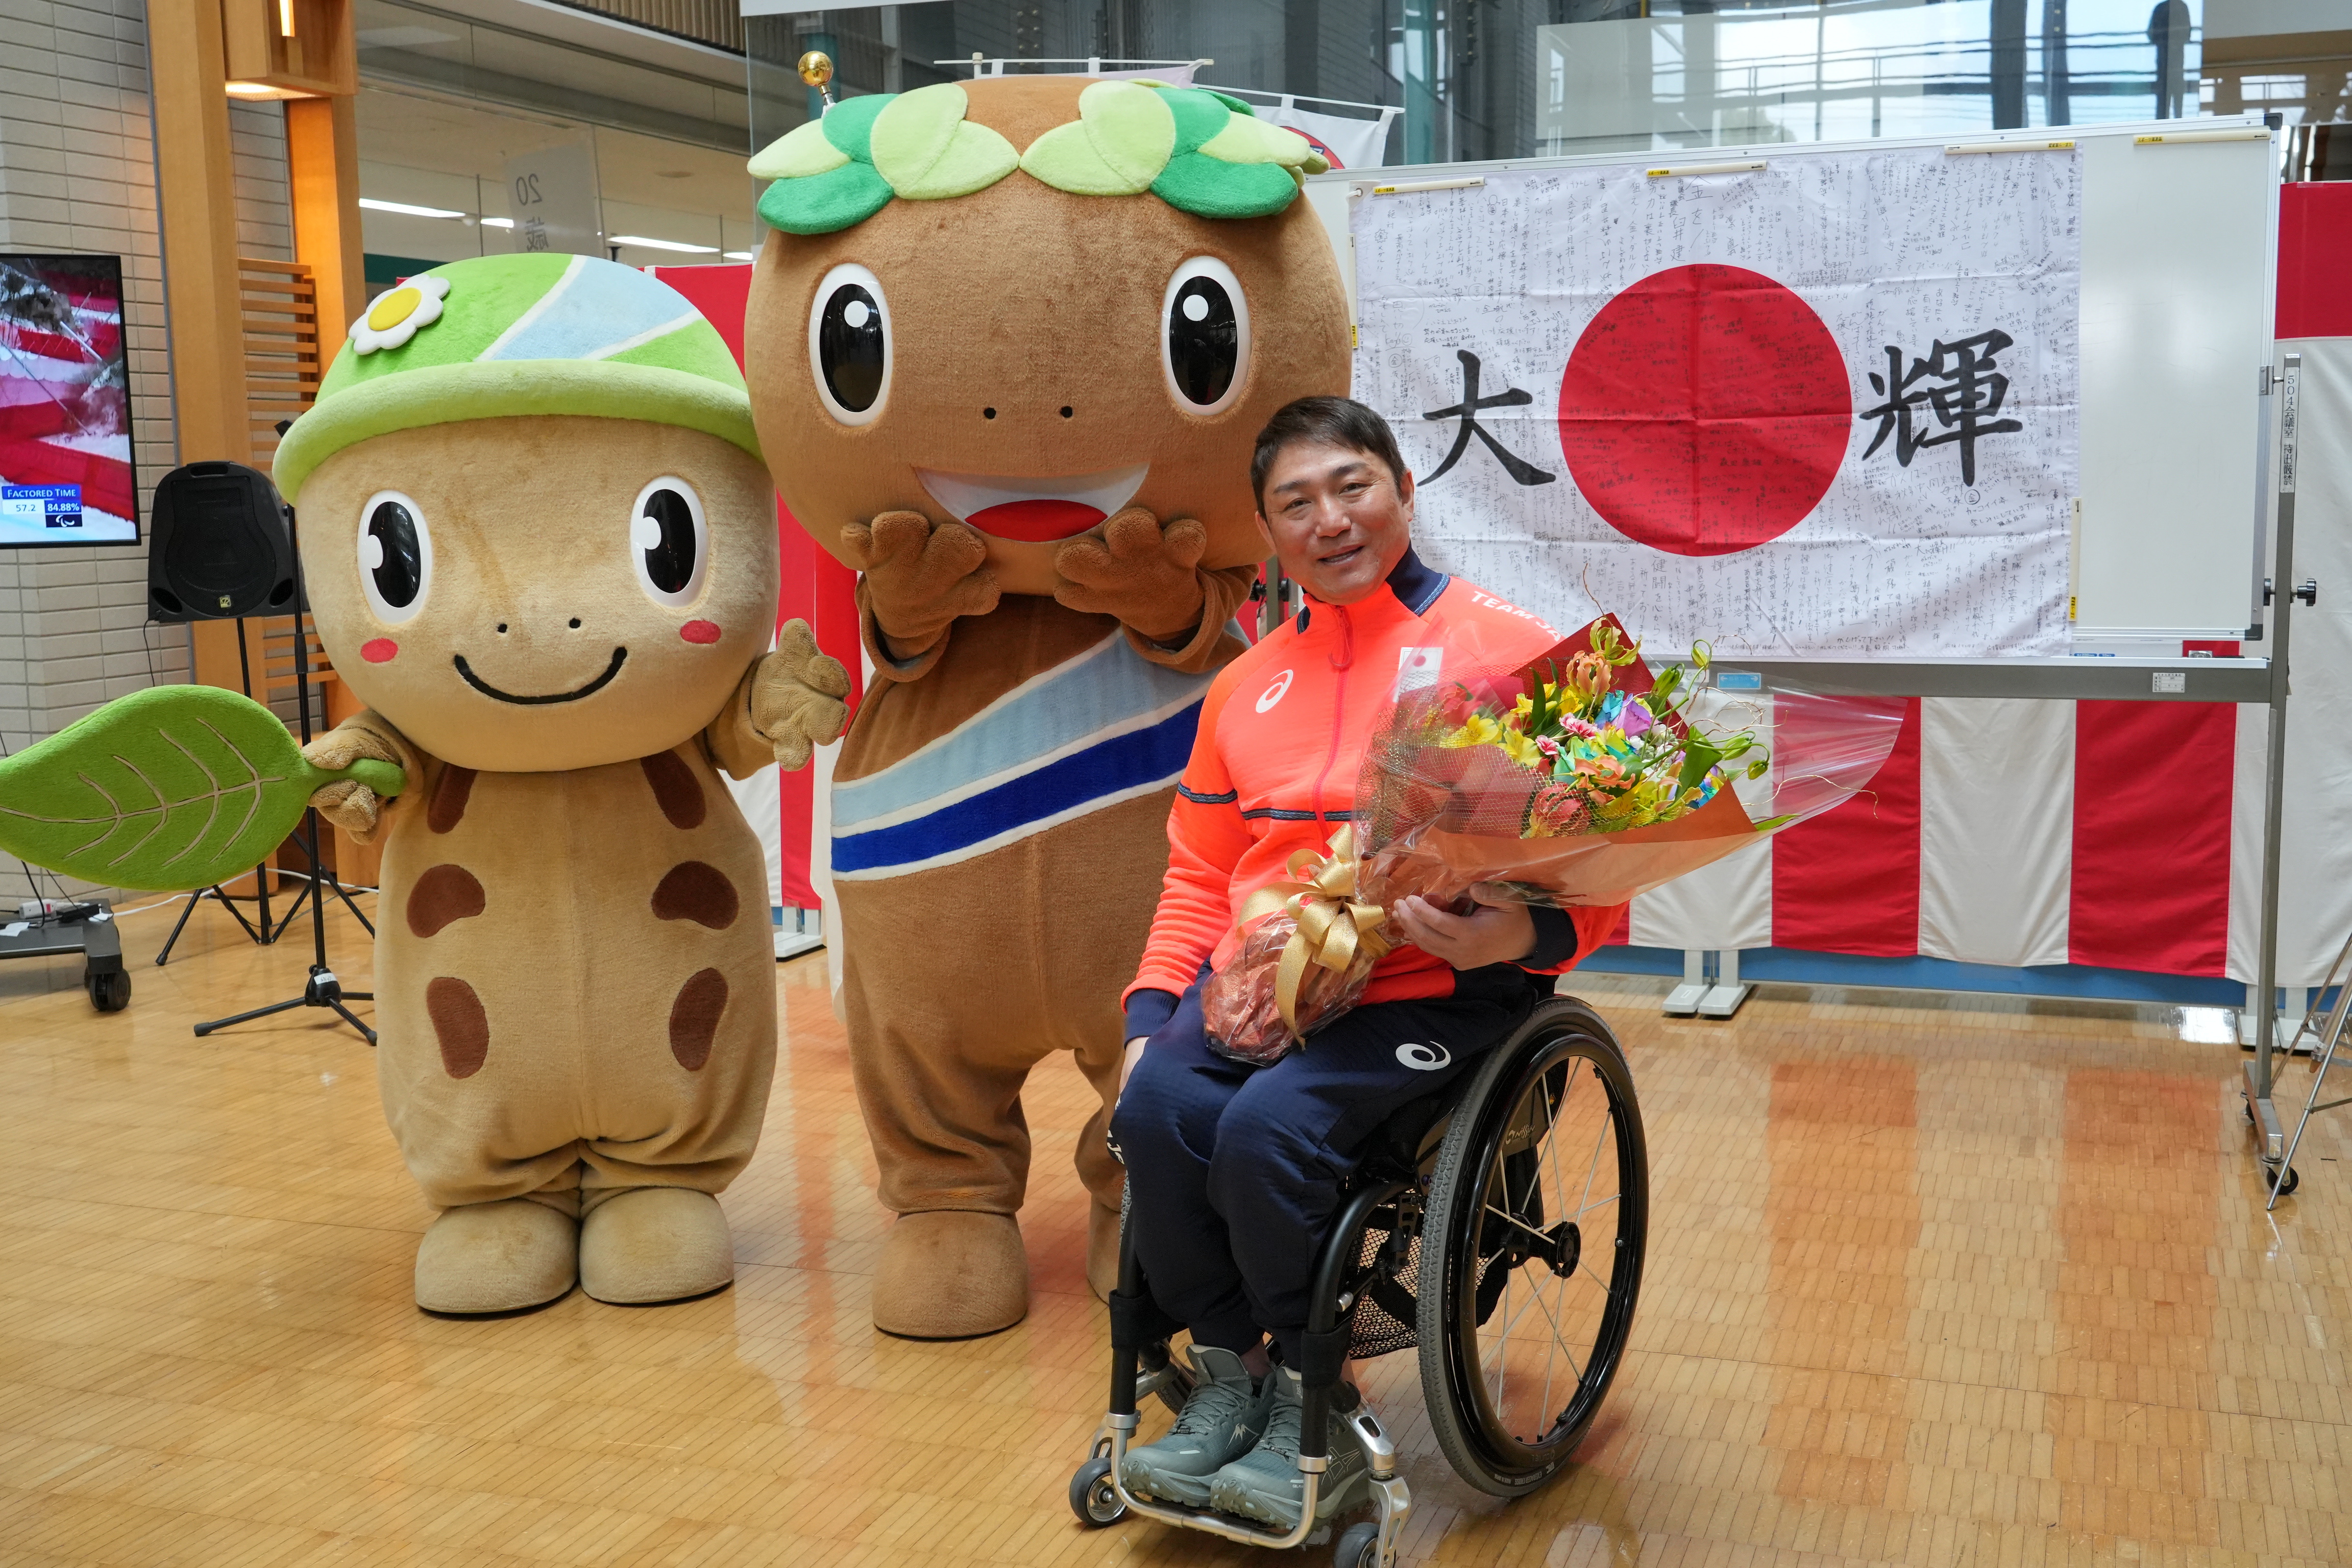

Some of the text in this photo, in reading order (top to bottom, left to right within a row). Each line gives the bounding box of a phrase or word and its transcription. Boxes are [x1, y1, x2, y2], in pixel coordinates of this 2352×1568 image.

[1417, 350, 1556, 486] 大
[1859, 329, 2023, 487] 輝
[2284, 375, 2295, 438] 504会議室
[7, 488, 76, 498] FACTORED TIME
[16, 504, 36, 512] 57.2
[47, 502, 80, 512] 84.88%
[1472, 591, 1561, 642] TEAM JA
